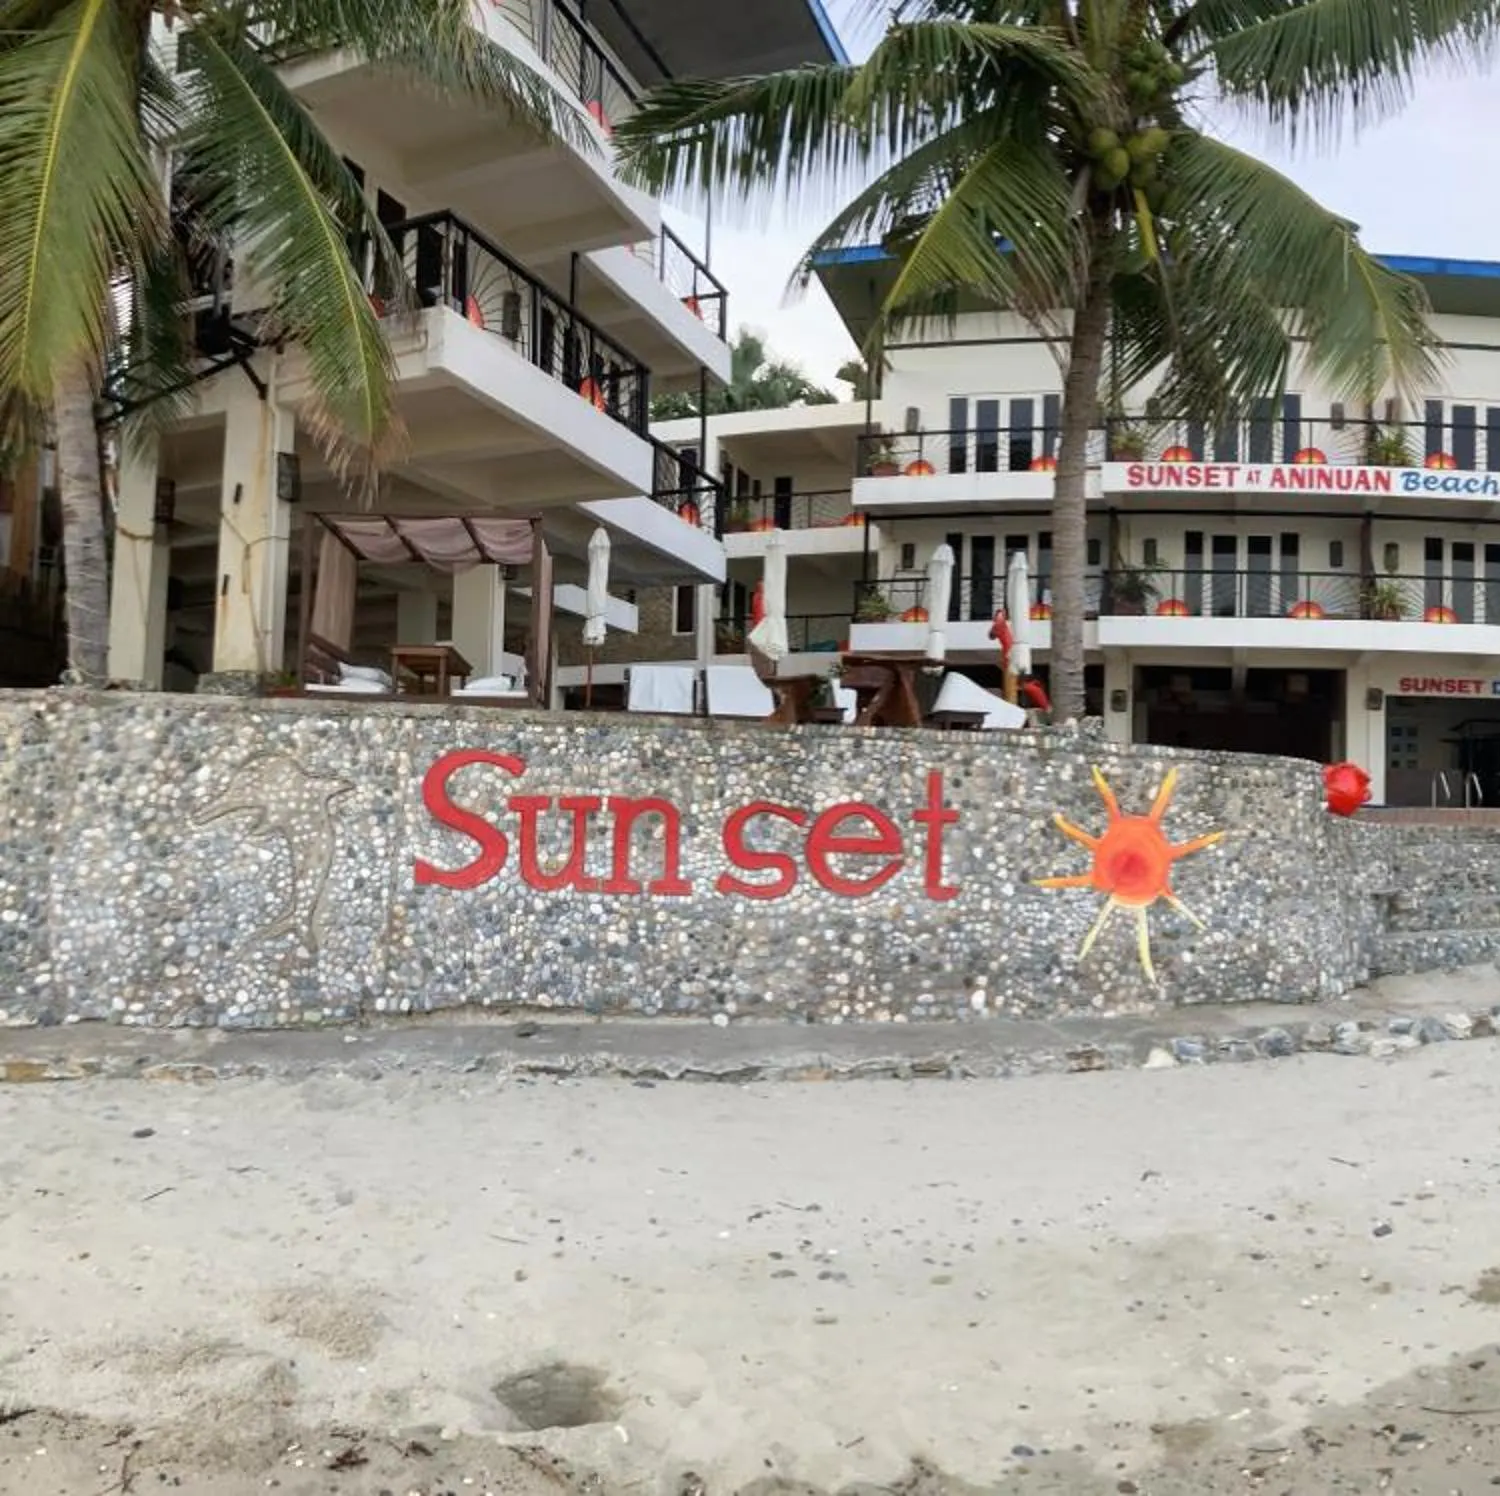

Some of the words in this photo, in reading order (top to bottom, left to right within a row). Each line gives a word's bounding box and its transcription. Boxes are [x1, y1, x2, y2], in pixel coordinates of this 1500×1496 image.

[1127, 464, 1240, 487] SUNSET
[1246, 470, 1261, 483] AT
[1269, 467, 1392, 492] ANINUAN
[1401, 471, 1499, 496] Beach
[1399, 677, 1484, 695] SUNSET
[415, 749, 962, 902] Sunset
